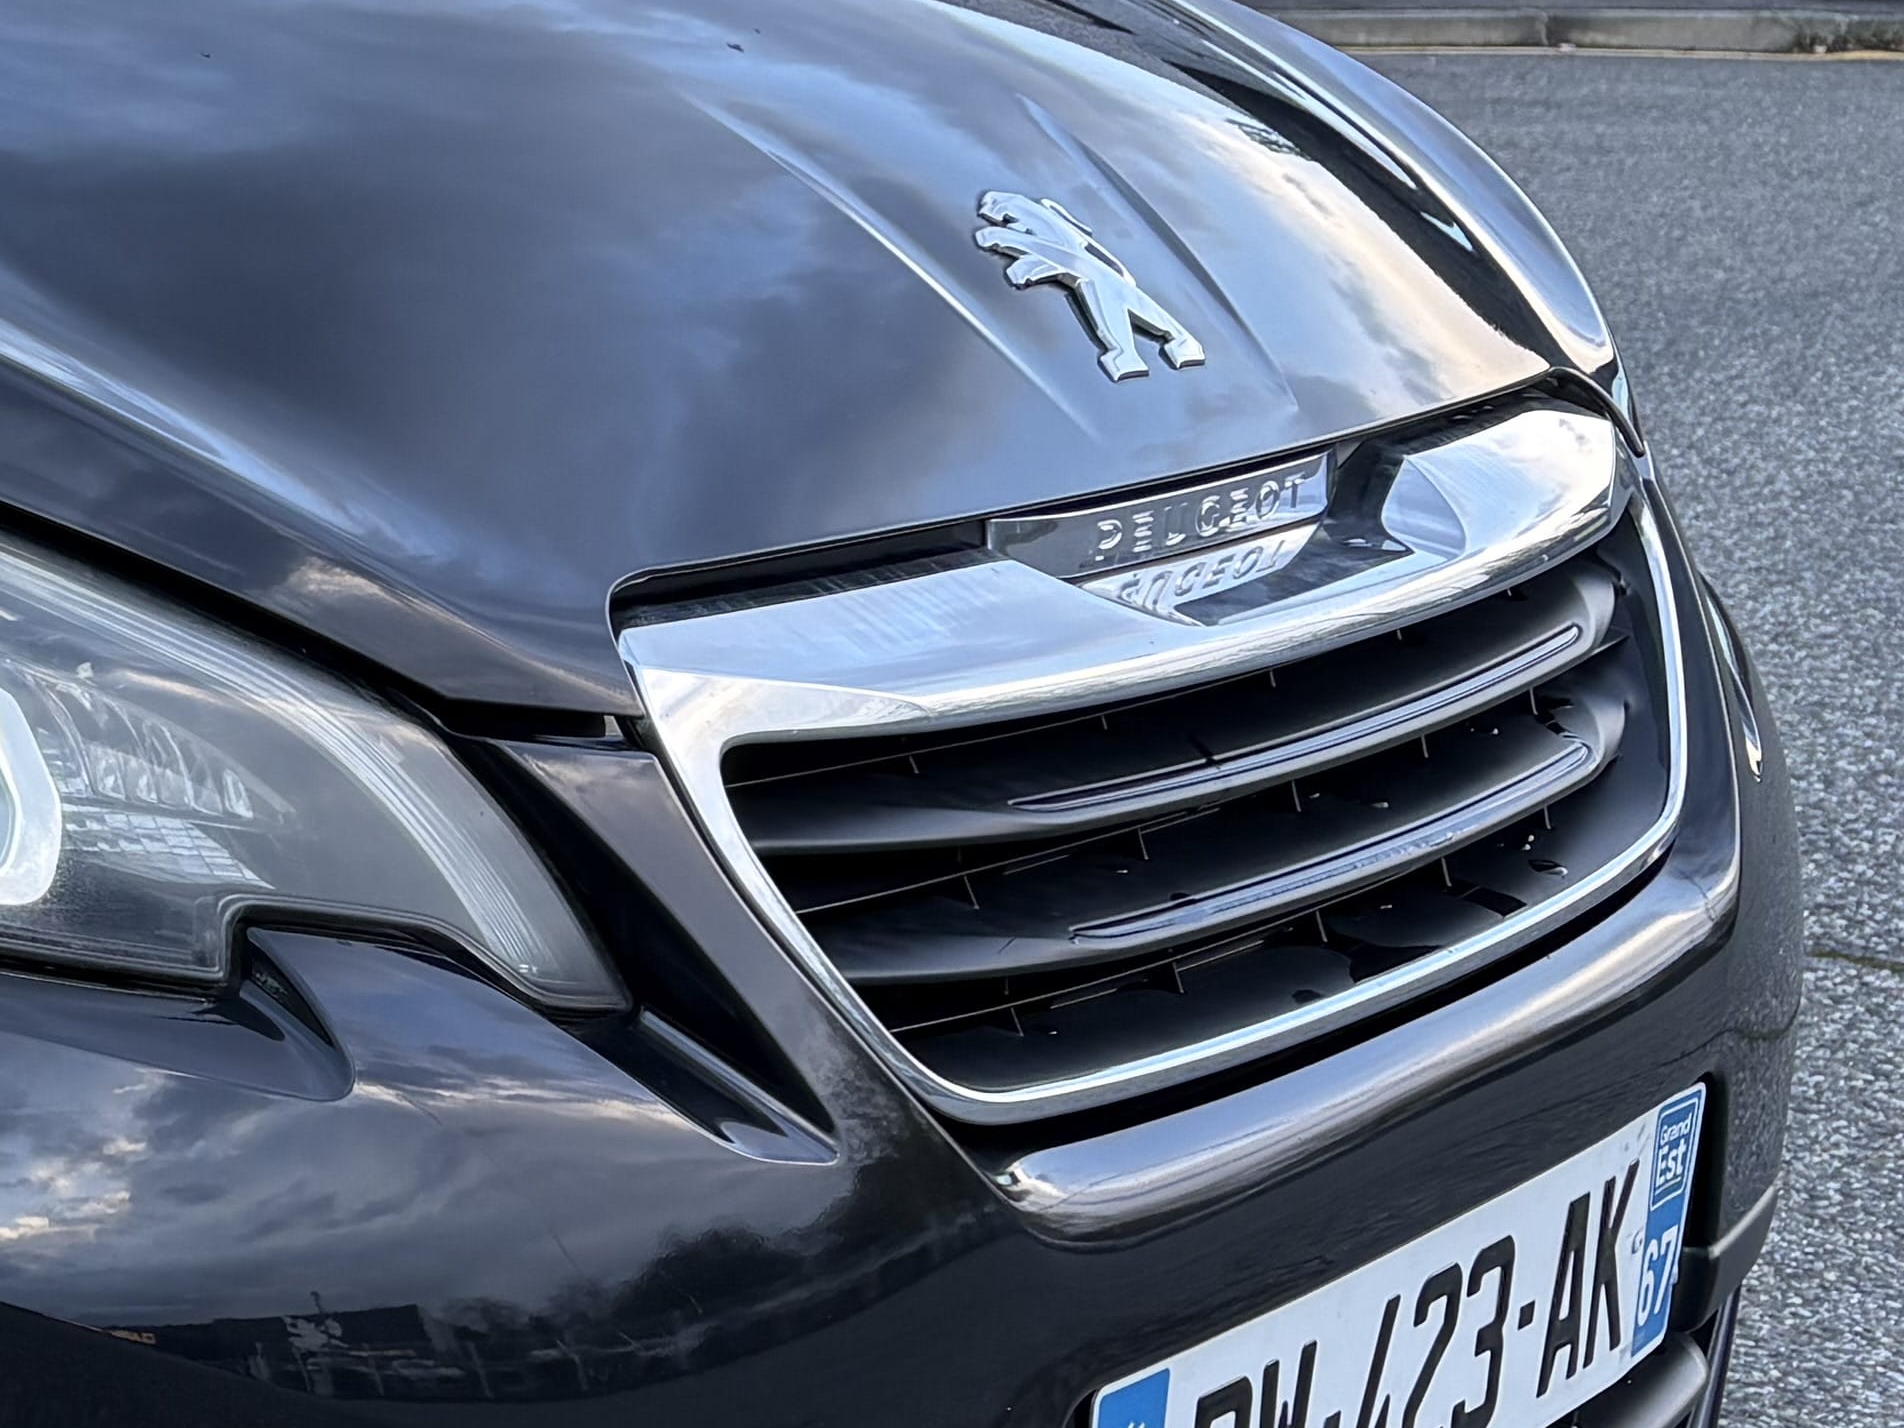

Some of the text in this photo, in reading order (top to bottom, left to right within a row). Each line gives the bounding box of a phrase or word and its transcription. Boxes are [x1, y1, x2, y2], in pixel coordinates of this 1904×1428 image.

[1092, 471, 1306, 562] PEUGEOT
[1655, 1138, 1688, 1186] Est
[1660, 1112, 1692, 1146] Grand
[1636, 1224, 1679, 1327] 67
